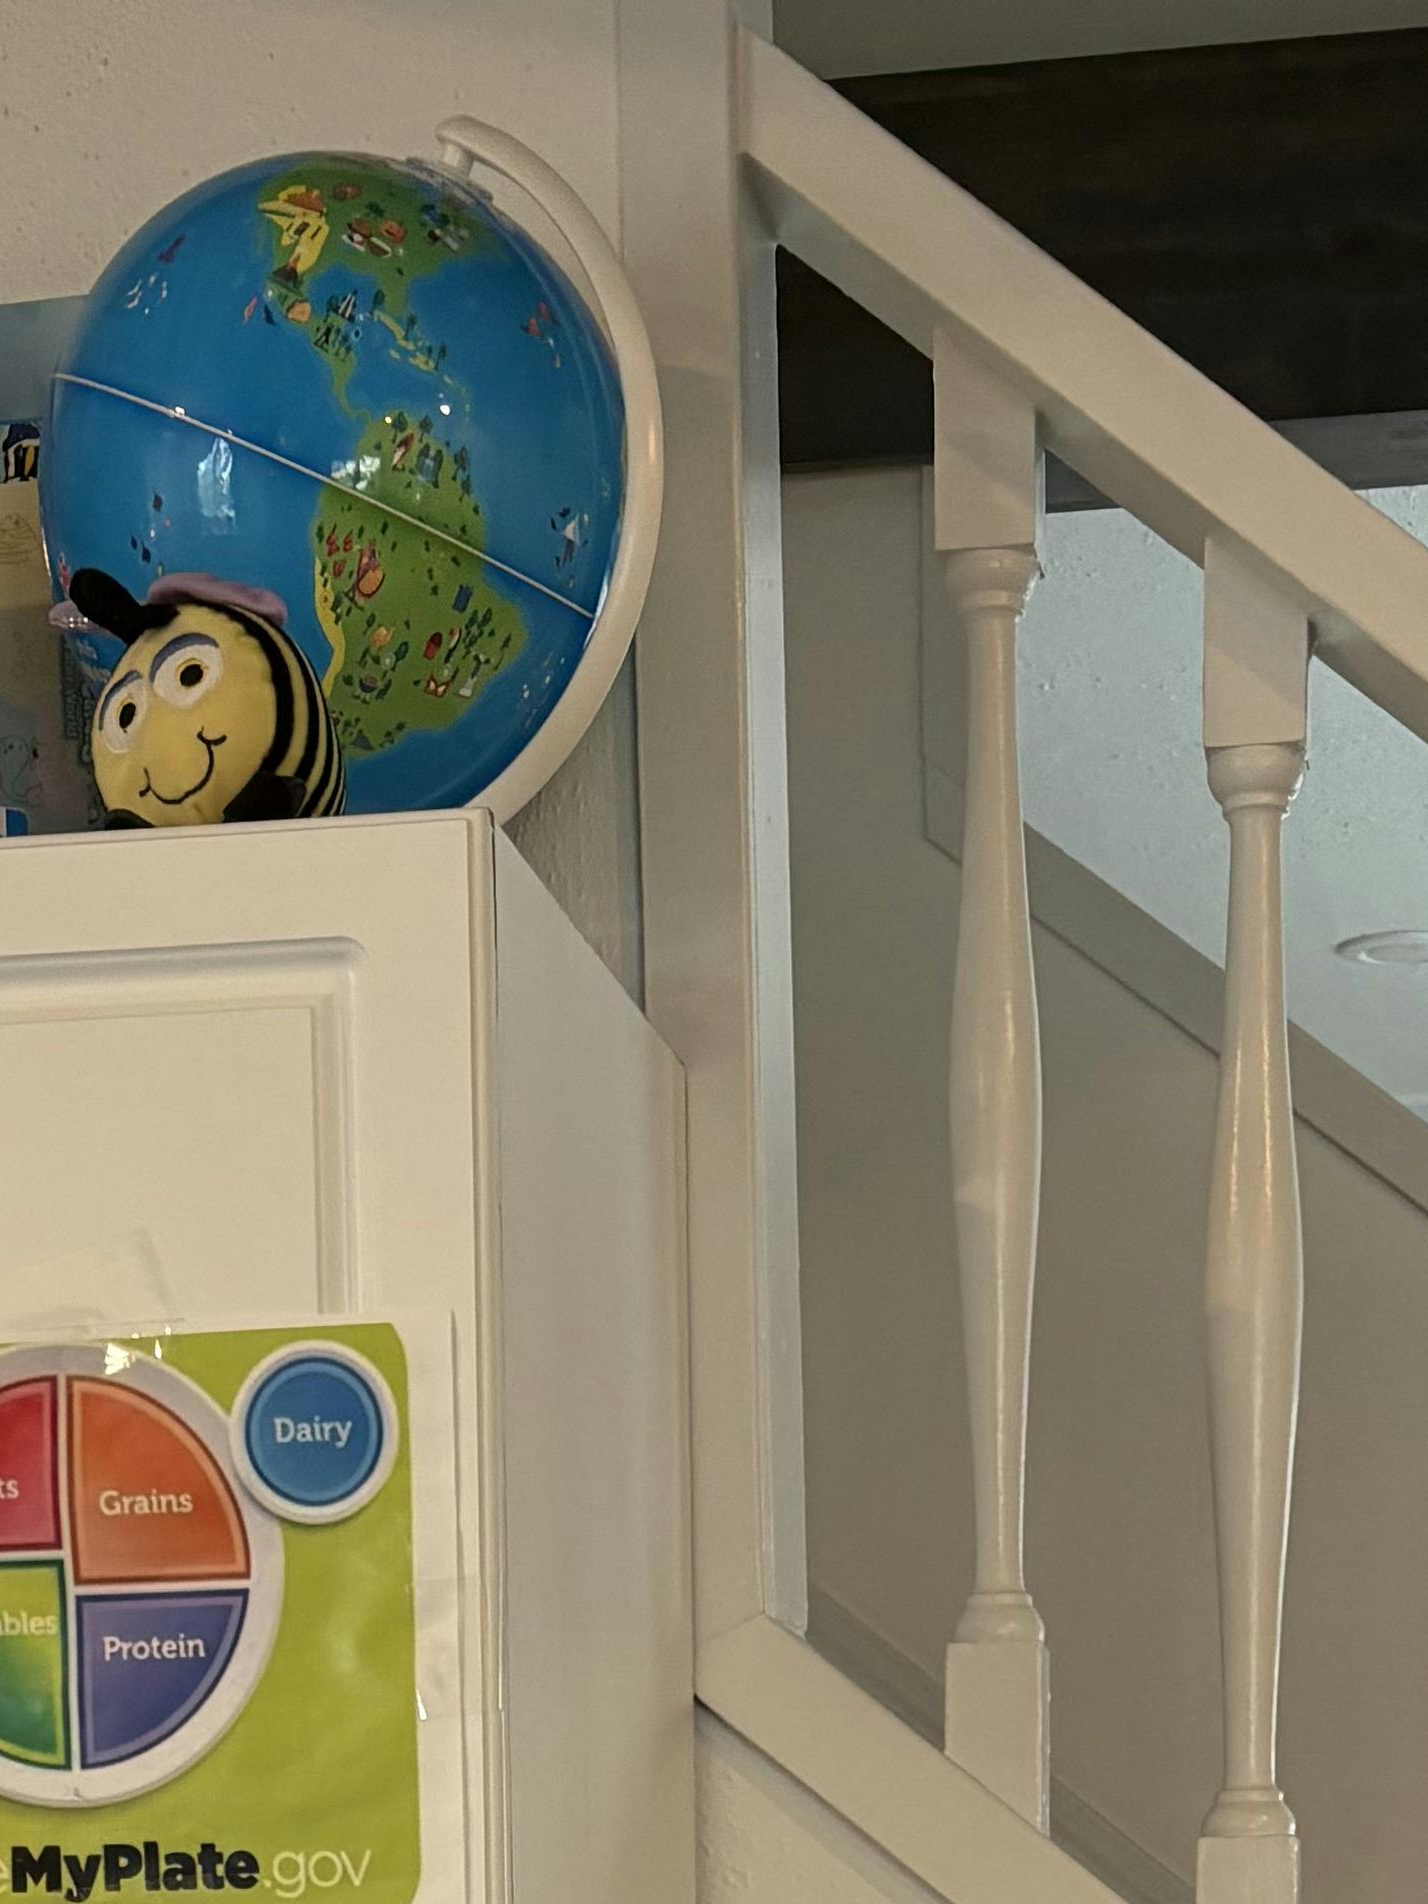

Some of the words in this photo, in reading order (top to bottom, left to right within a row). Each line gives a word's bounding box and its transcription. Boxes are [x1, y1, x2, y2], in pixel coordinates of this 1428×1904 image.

[273, 1416, 352, 1449] Dairy
[98, 1488, 193, 1518] Grains
[102, 1635, 206, 1661] Protein
